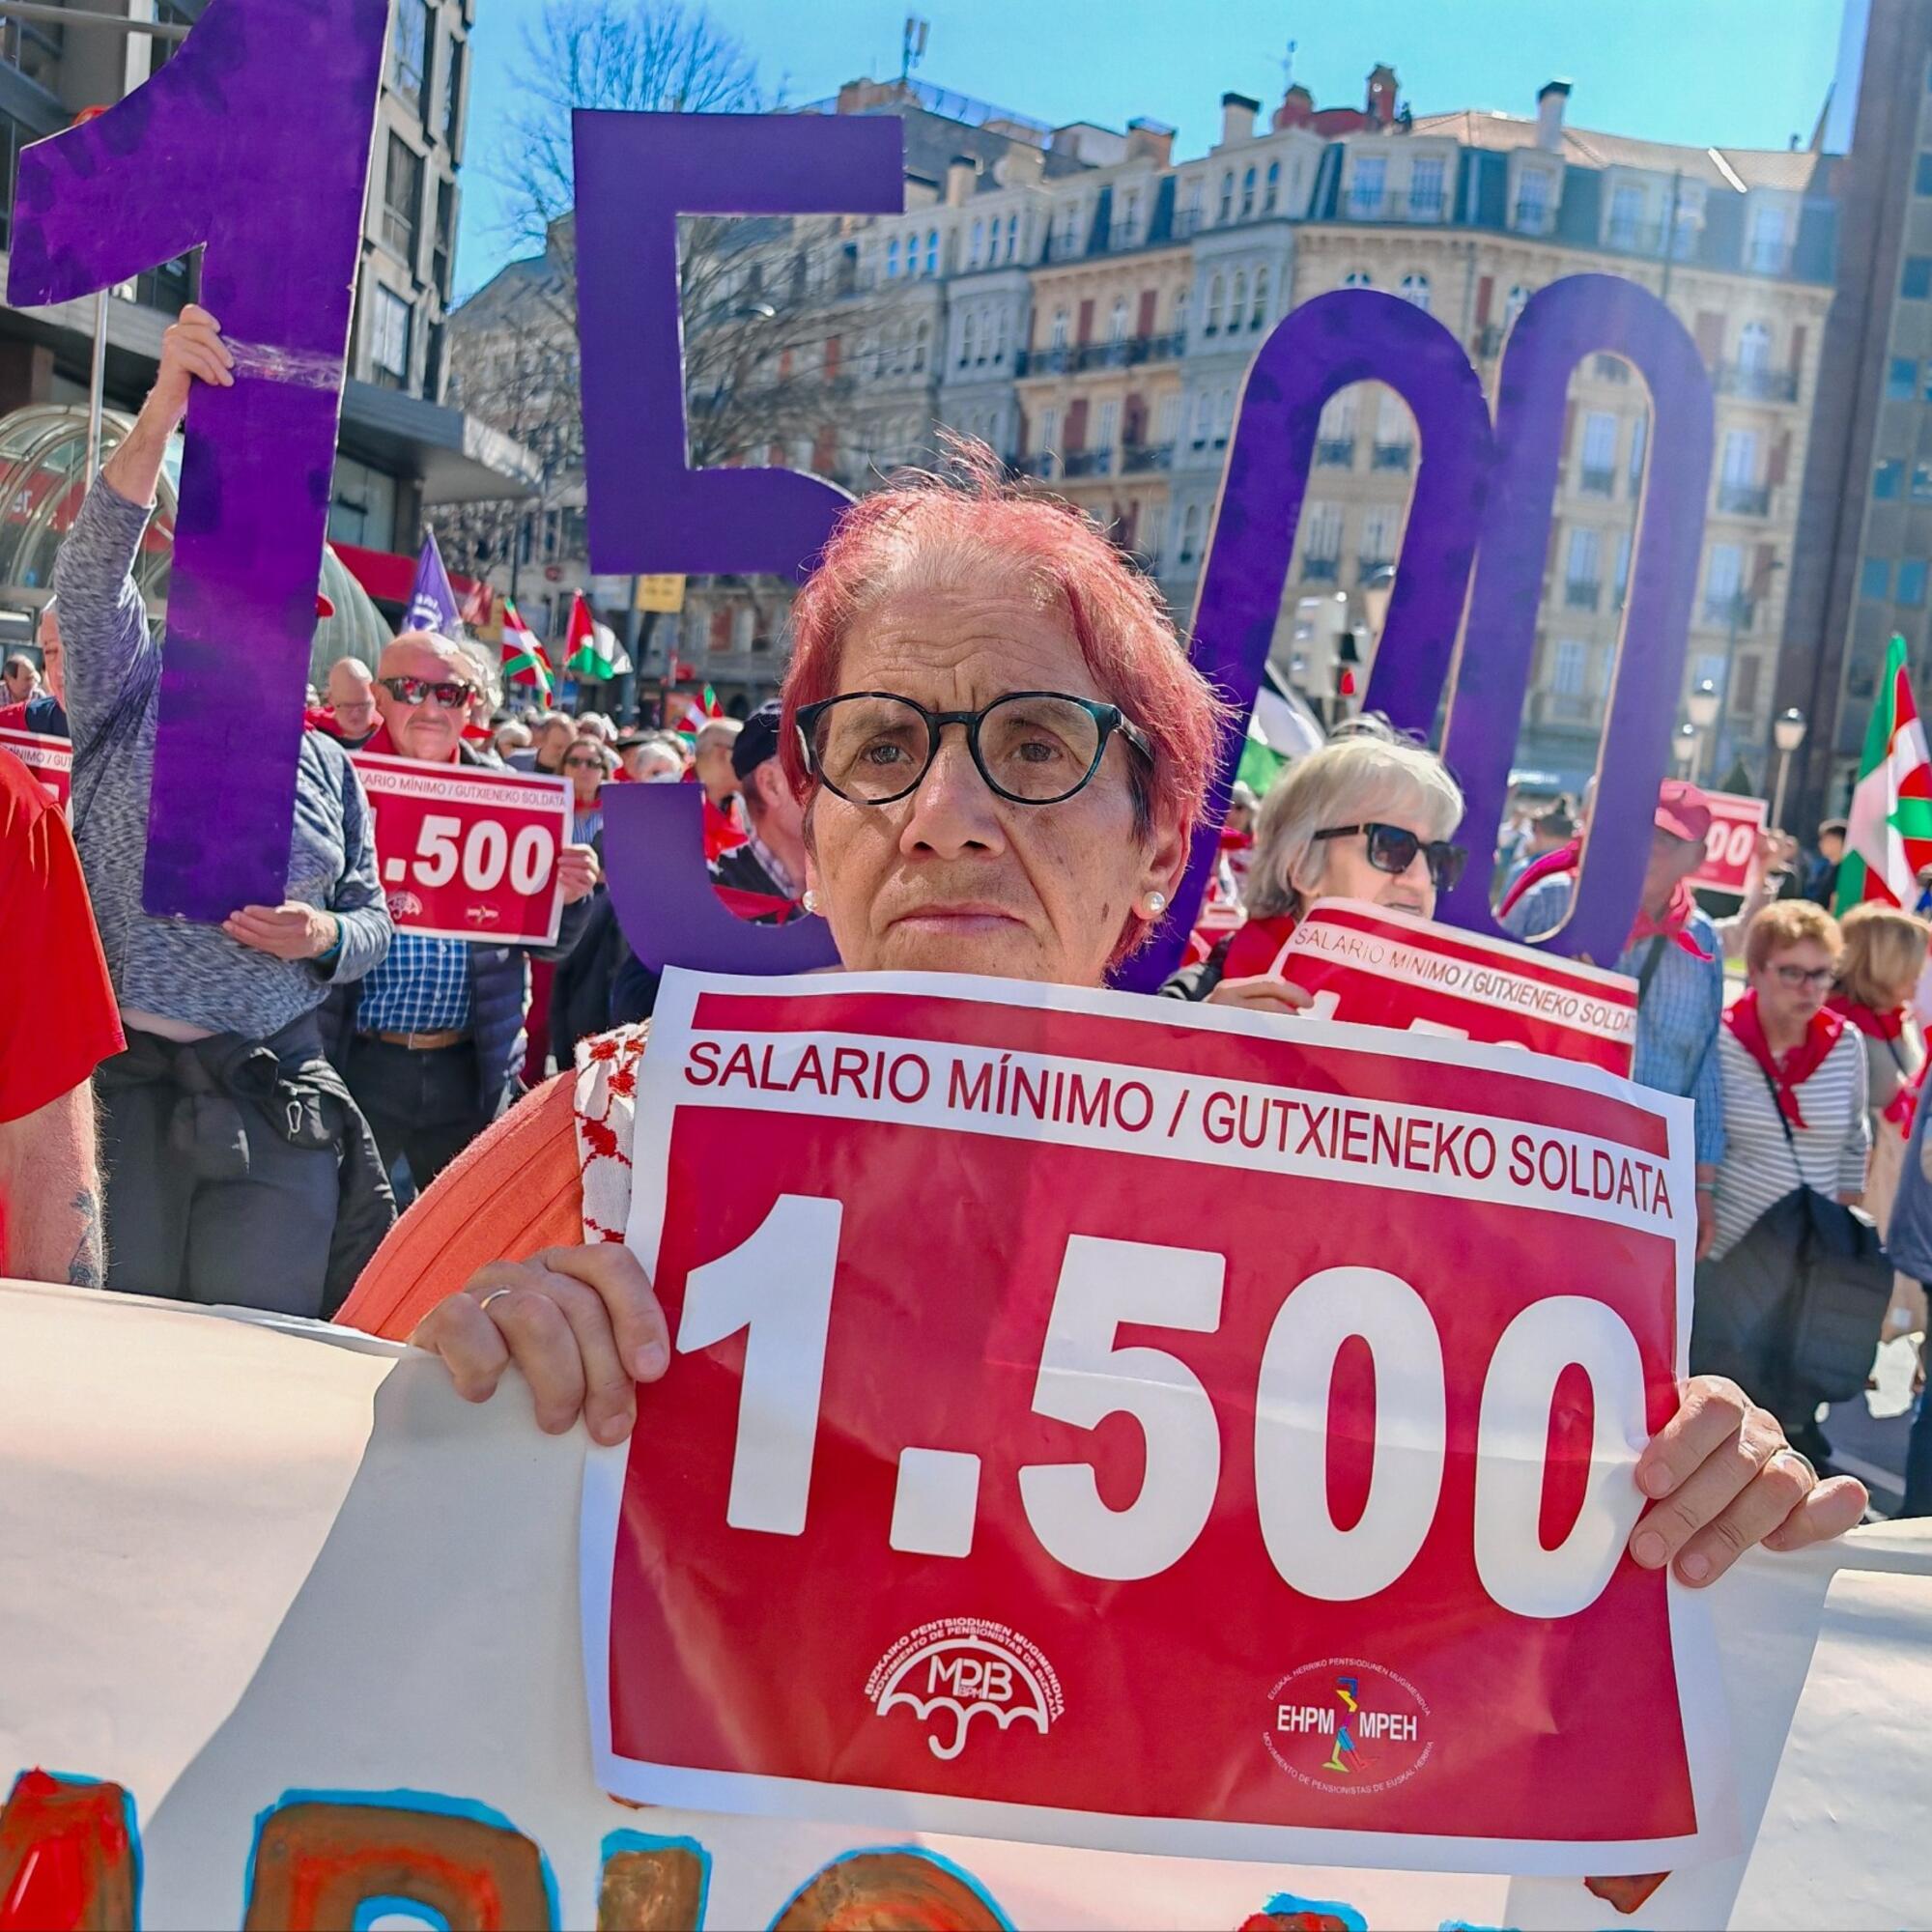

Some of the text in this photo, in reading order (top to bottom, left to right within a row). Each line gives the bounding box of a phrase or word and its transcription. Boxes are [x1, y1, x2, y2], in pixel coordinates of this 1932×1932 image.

[400, 776, 446, 795] MÍNIMO
[455, 784, 521, 804] GUTXIENEKO
[522, 791, 565, 807] SOLDATA
[1293, 926, 1385, 966] SALARIO
[1462, 969, 1473, 989] /
[1473, 970, 1579, 1018] GUTXIENEKO
[684, 1040, 1674, 1221] SALARIO MÍNIMO / GUTXIENEKO SOLDATA
[675, 1193, 1651, 1619] 1.500
[864, 1617, 1065, 1717] BIZKAIKO PENTSIODUNEN MUGIMENDUA
[869, 1626, 1058, 1722] MOVIMIENTO DE PENSIONISTAS DE BIZKAIA
[1267, 1658, 1432, 1717] EUSKAL HERRIKO PENTSIODUNEN MUGIMENDUA
[1262, 1731, 1435, 1795] MOVIMIENTO DE PENSIONISTAS DE EUSKAL HERRIA
[1277, 1705, 1417, 1741] EHPM MPEH
